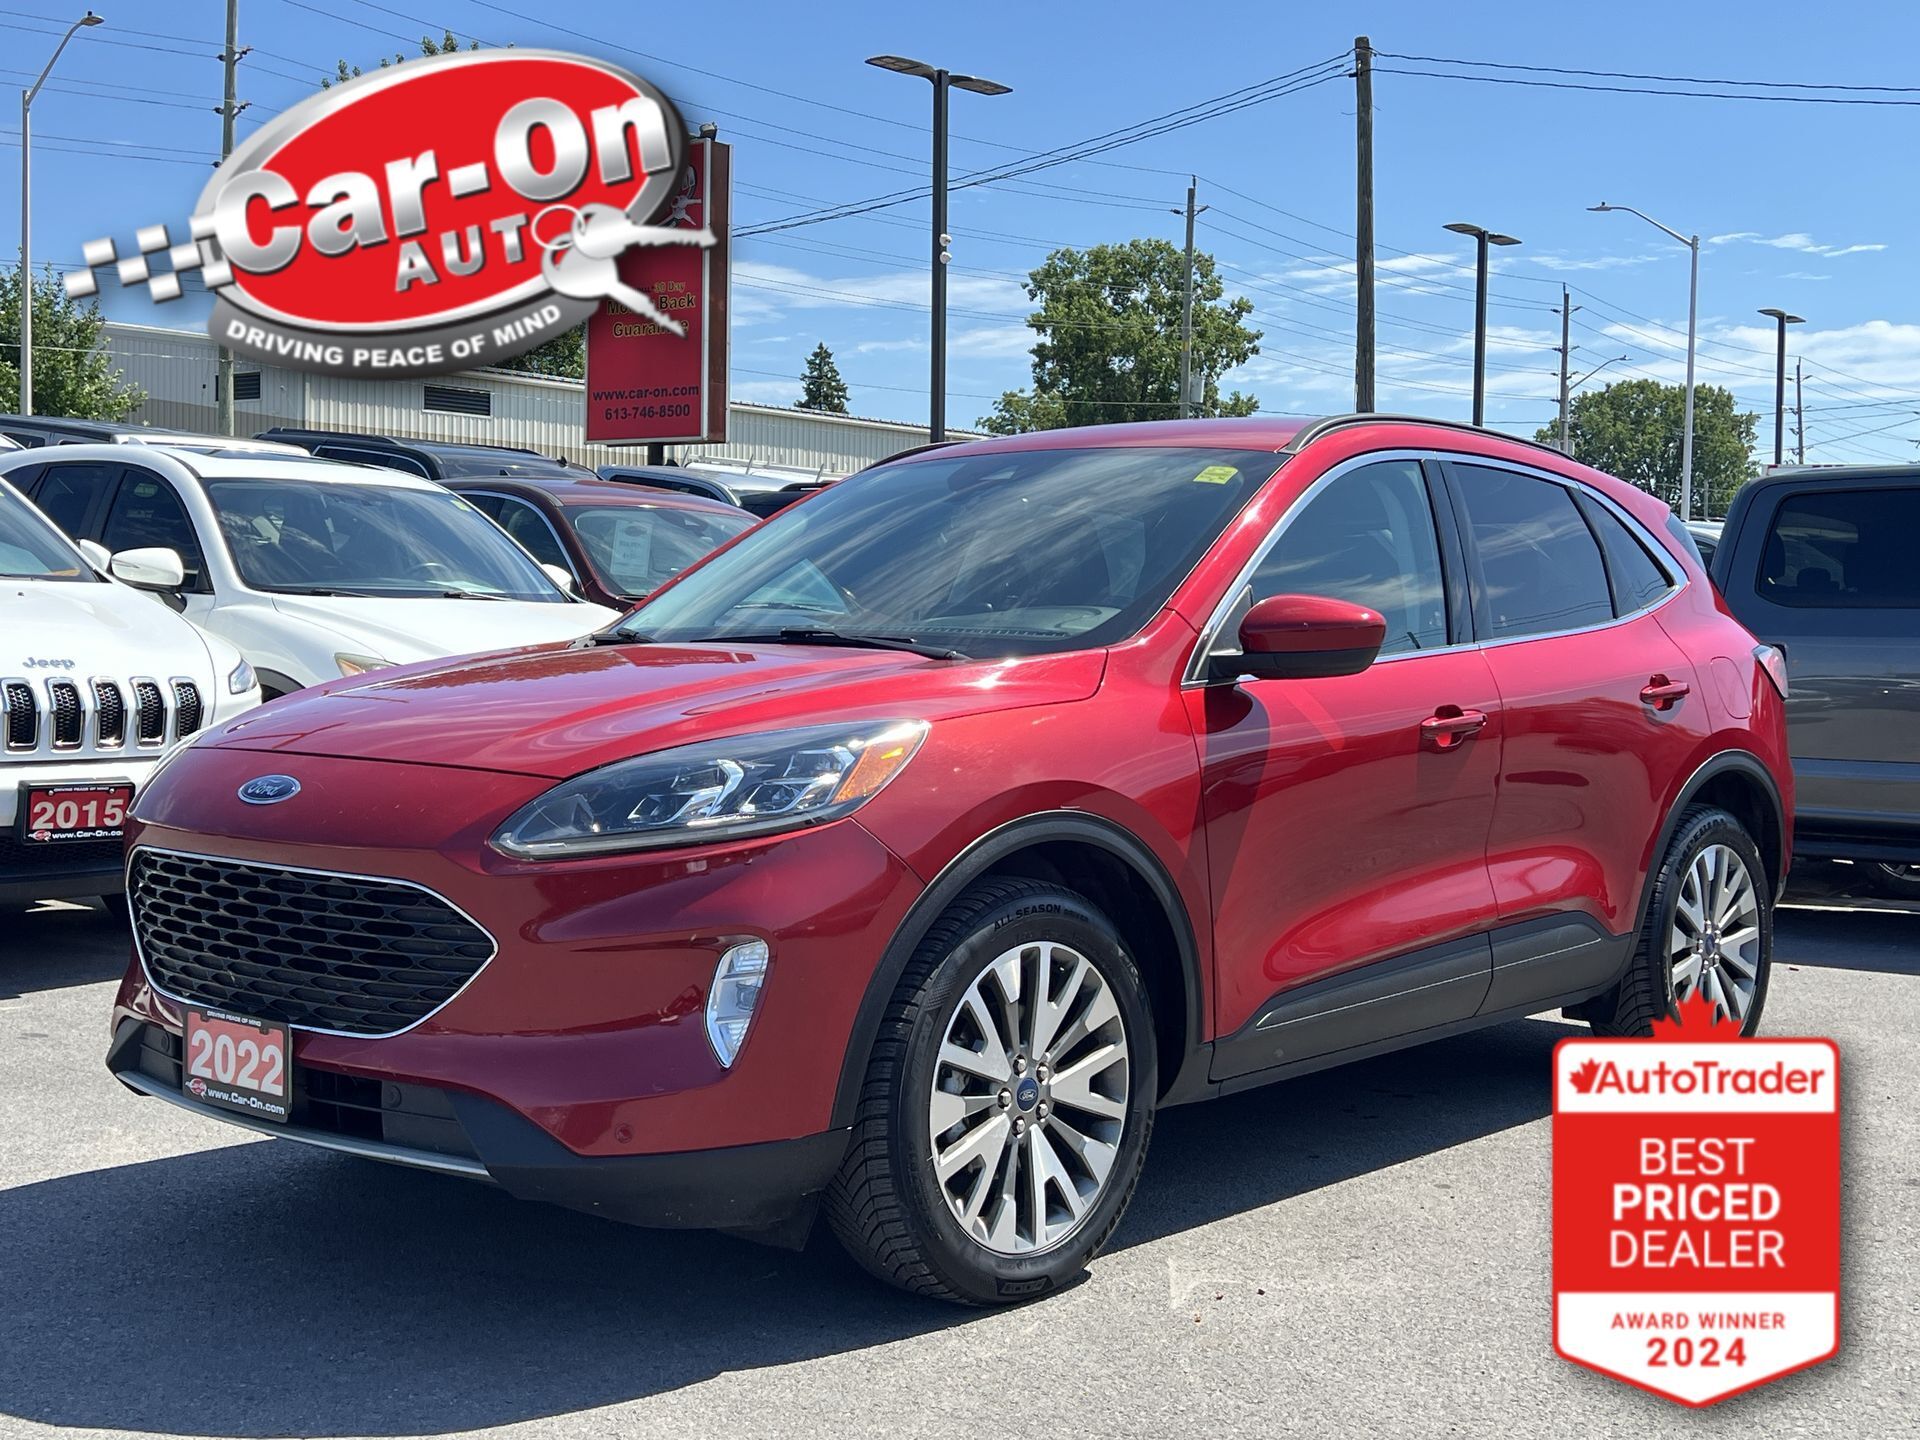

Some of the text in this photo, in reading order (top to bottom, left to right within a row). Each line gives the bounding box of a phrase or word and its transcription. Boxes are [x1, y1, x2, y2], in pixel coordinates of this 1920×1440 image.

[659, 292, 696, 311] Back
[593, 386, 699, 400] www.car-on.com
[605, 404, 690, 420] 613-746-8500
[22, 656, 76, 670] Jeep
[247, 779, 285, 796] Ford
[32, 799, 124, 830] 2015
[52, 829, 124, 839] www.Car-On.co
[994, 914, 1014, 932] ALL
[1016, 904, 1062, 919] SEASON
[191, 1029, 284, 1097] 2022
[207, 1087, 285, 1115] www.Car-On.com
